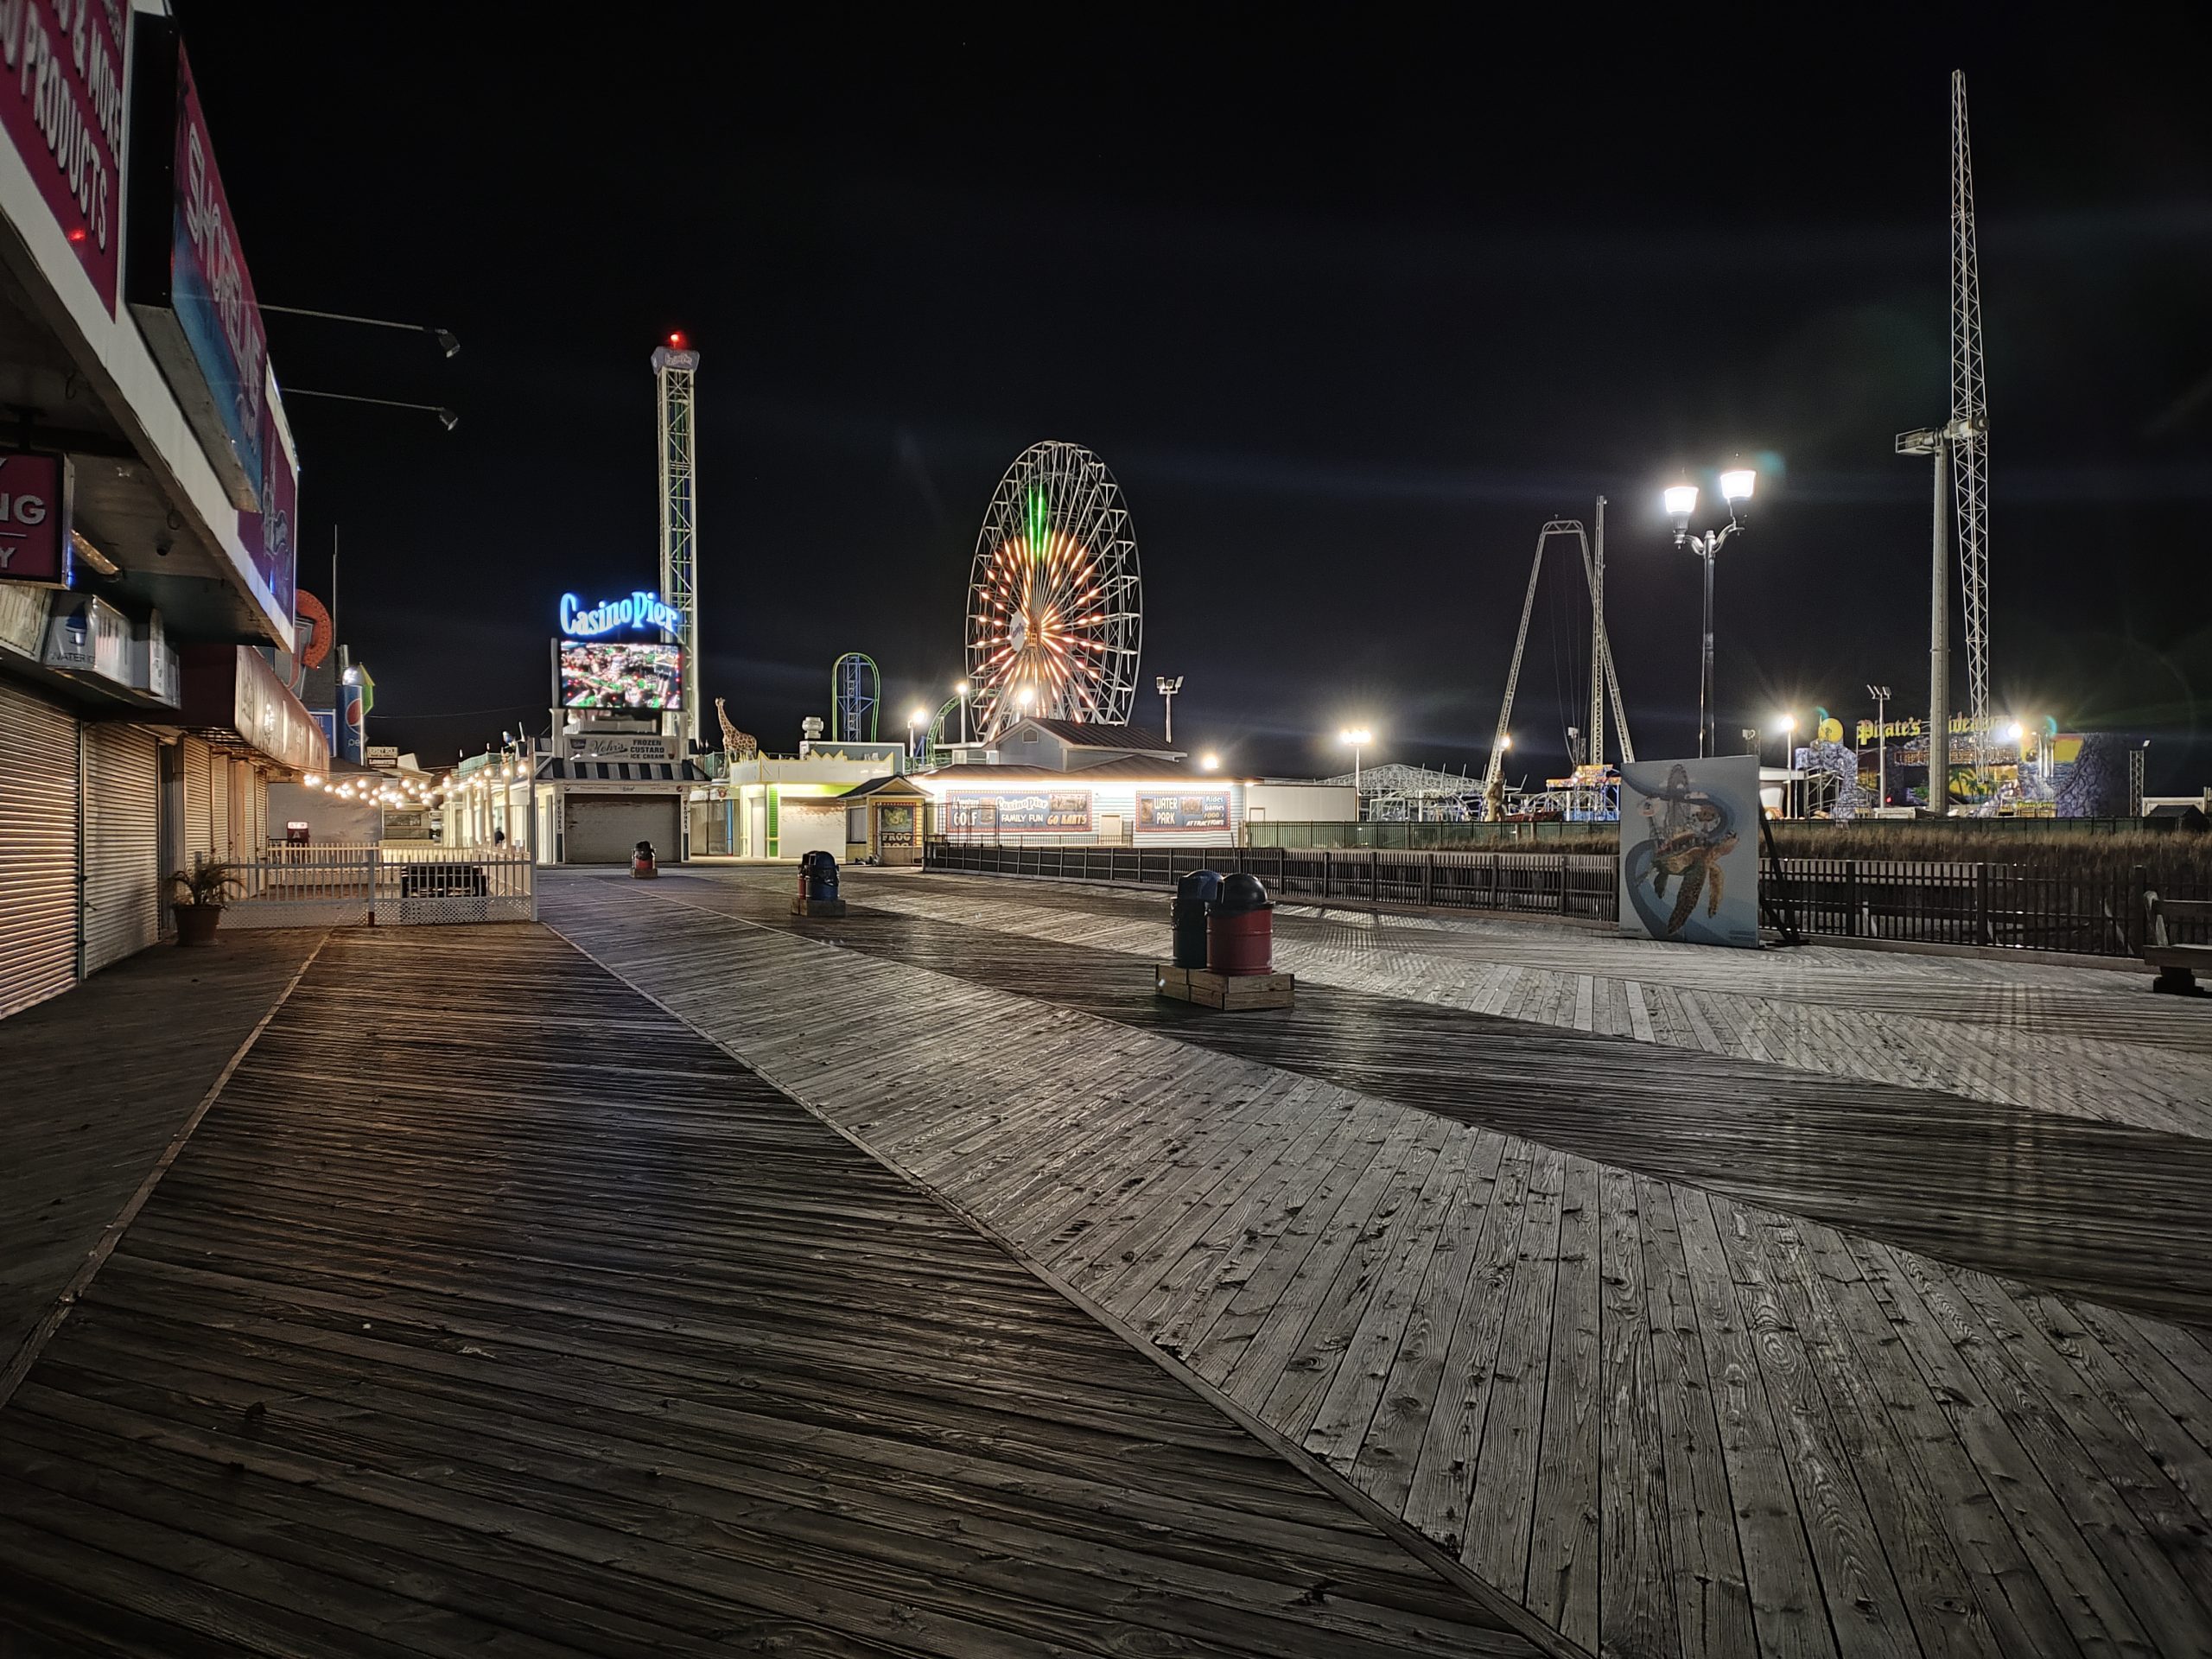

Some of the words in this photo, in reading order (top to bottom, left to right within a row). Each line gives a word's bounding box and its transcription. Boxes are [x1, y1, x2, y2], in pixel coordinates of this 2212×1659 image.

[22, 1, 106, 251] PRODUCTS
[560, 593, 632, 634] Casino
[632, 591, 677, 632] Pier
[1857, 716, 1922, 745] Piate's
[1154, 798, 1178, 810] WATER
[1001, 814, 1027, 823] FAMILY
[1046, 815, 1059, 825] GO
[1060, 814, 1088, 825] KARTS
[1156, 811, 1176, 824] PARK
[882, 832, 912, 842] FROG
